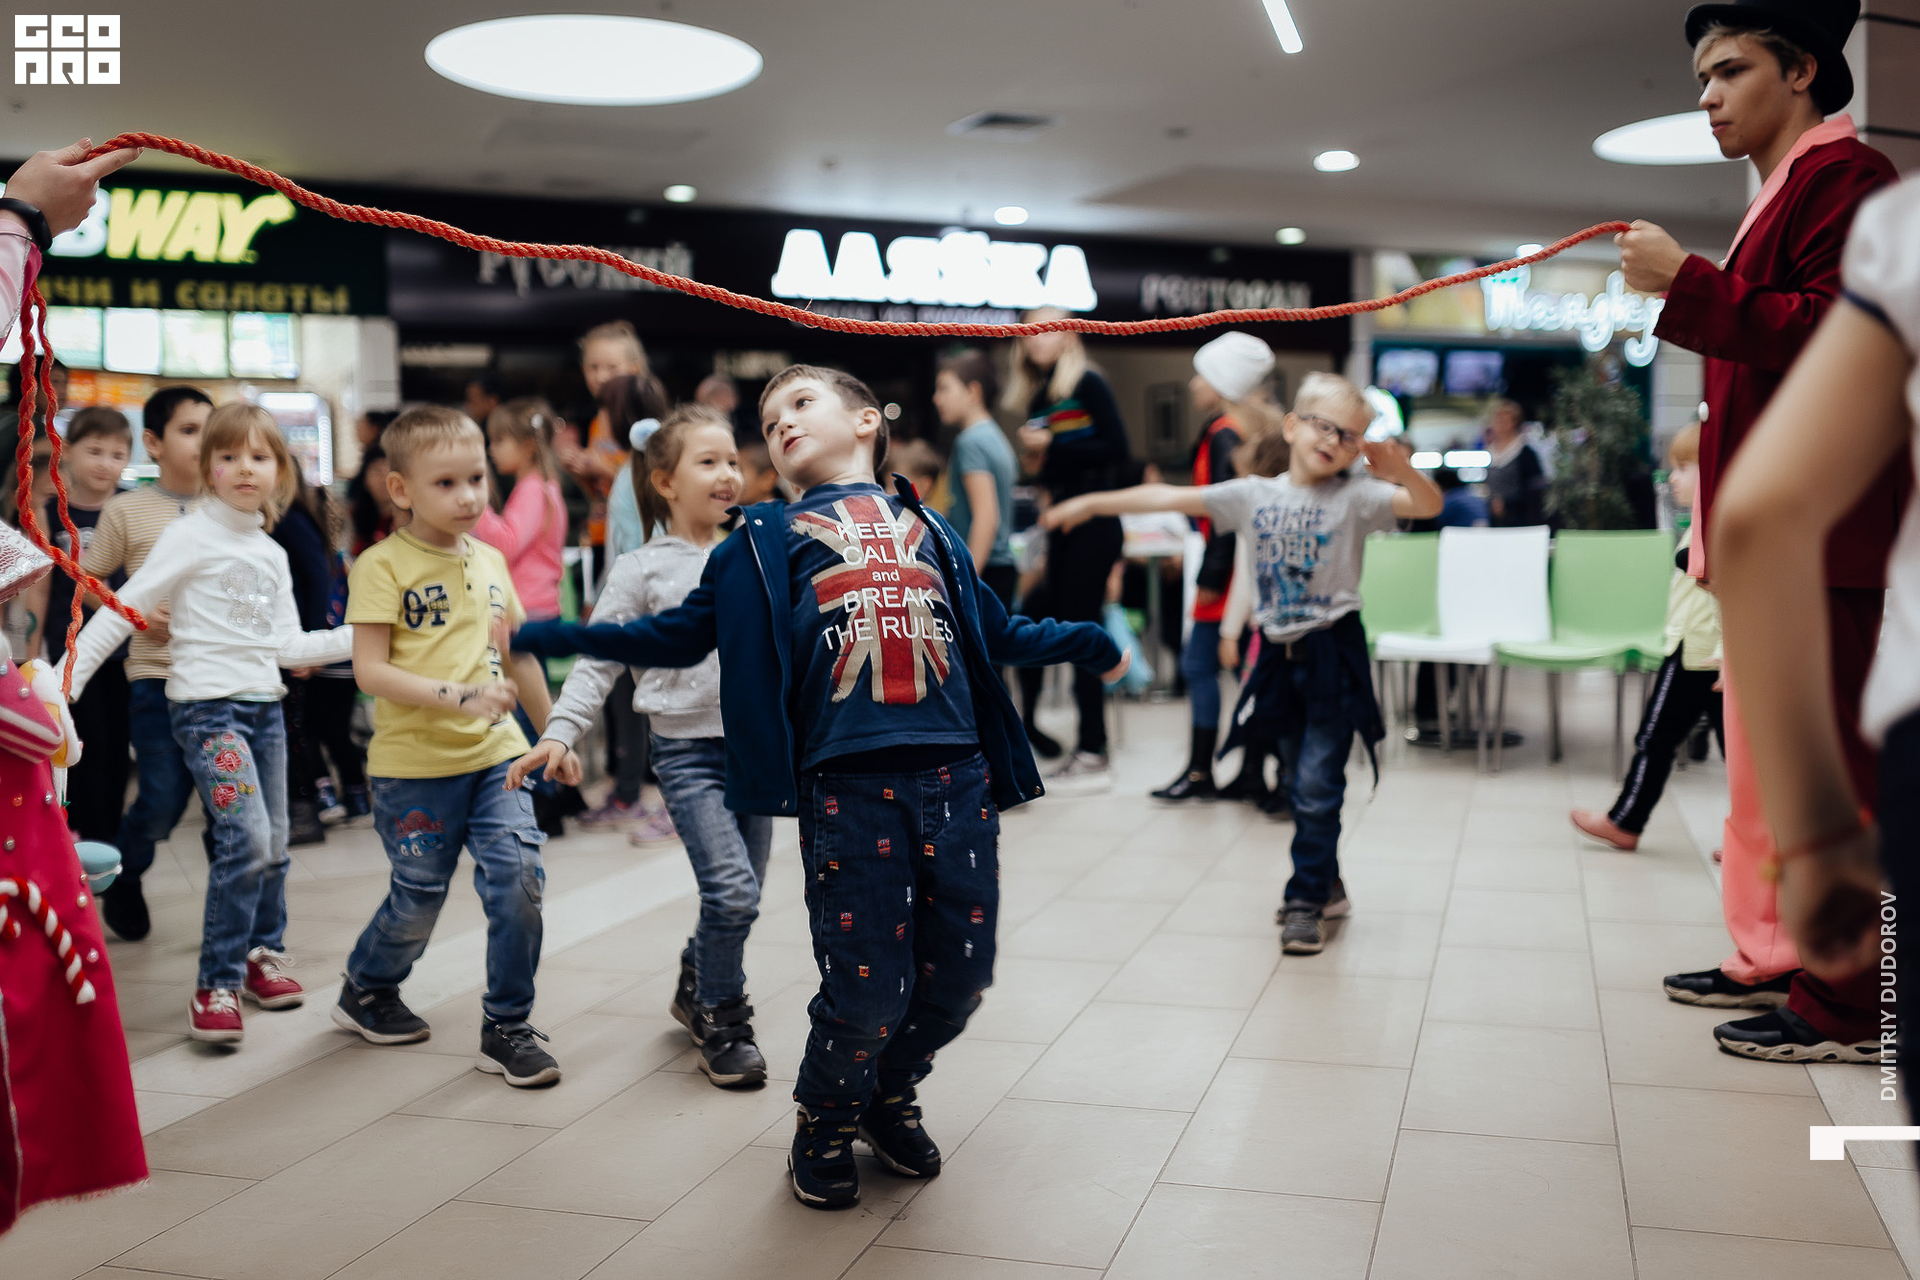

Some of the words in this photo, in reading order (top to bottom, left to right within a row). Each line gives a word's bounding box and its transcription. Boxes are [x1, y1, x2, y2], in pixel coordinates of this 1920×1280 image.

[48, 187, 297, 263] BWAY
[835, 522, 908, 541] KEEP
[842, 544, 917, 567] CALM
[871, 568, 900, 582] and
[843, 586, 935, 614] BREAK
[821, 618, 874, 650] THE
[880, 615, 954, 643] RULES
